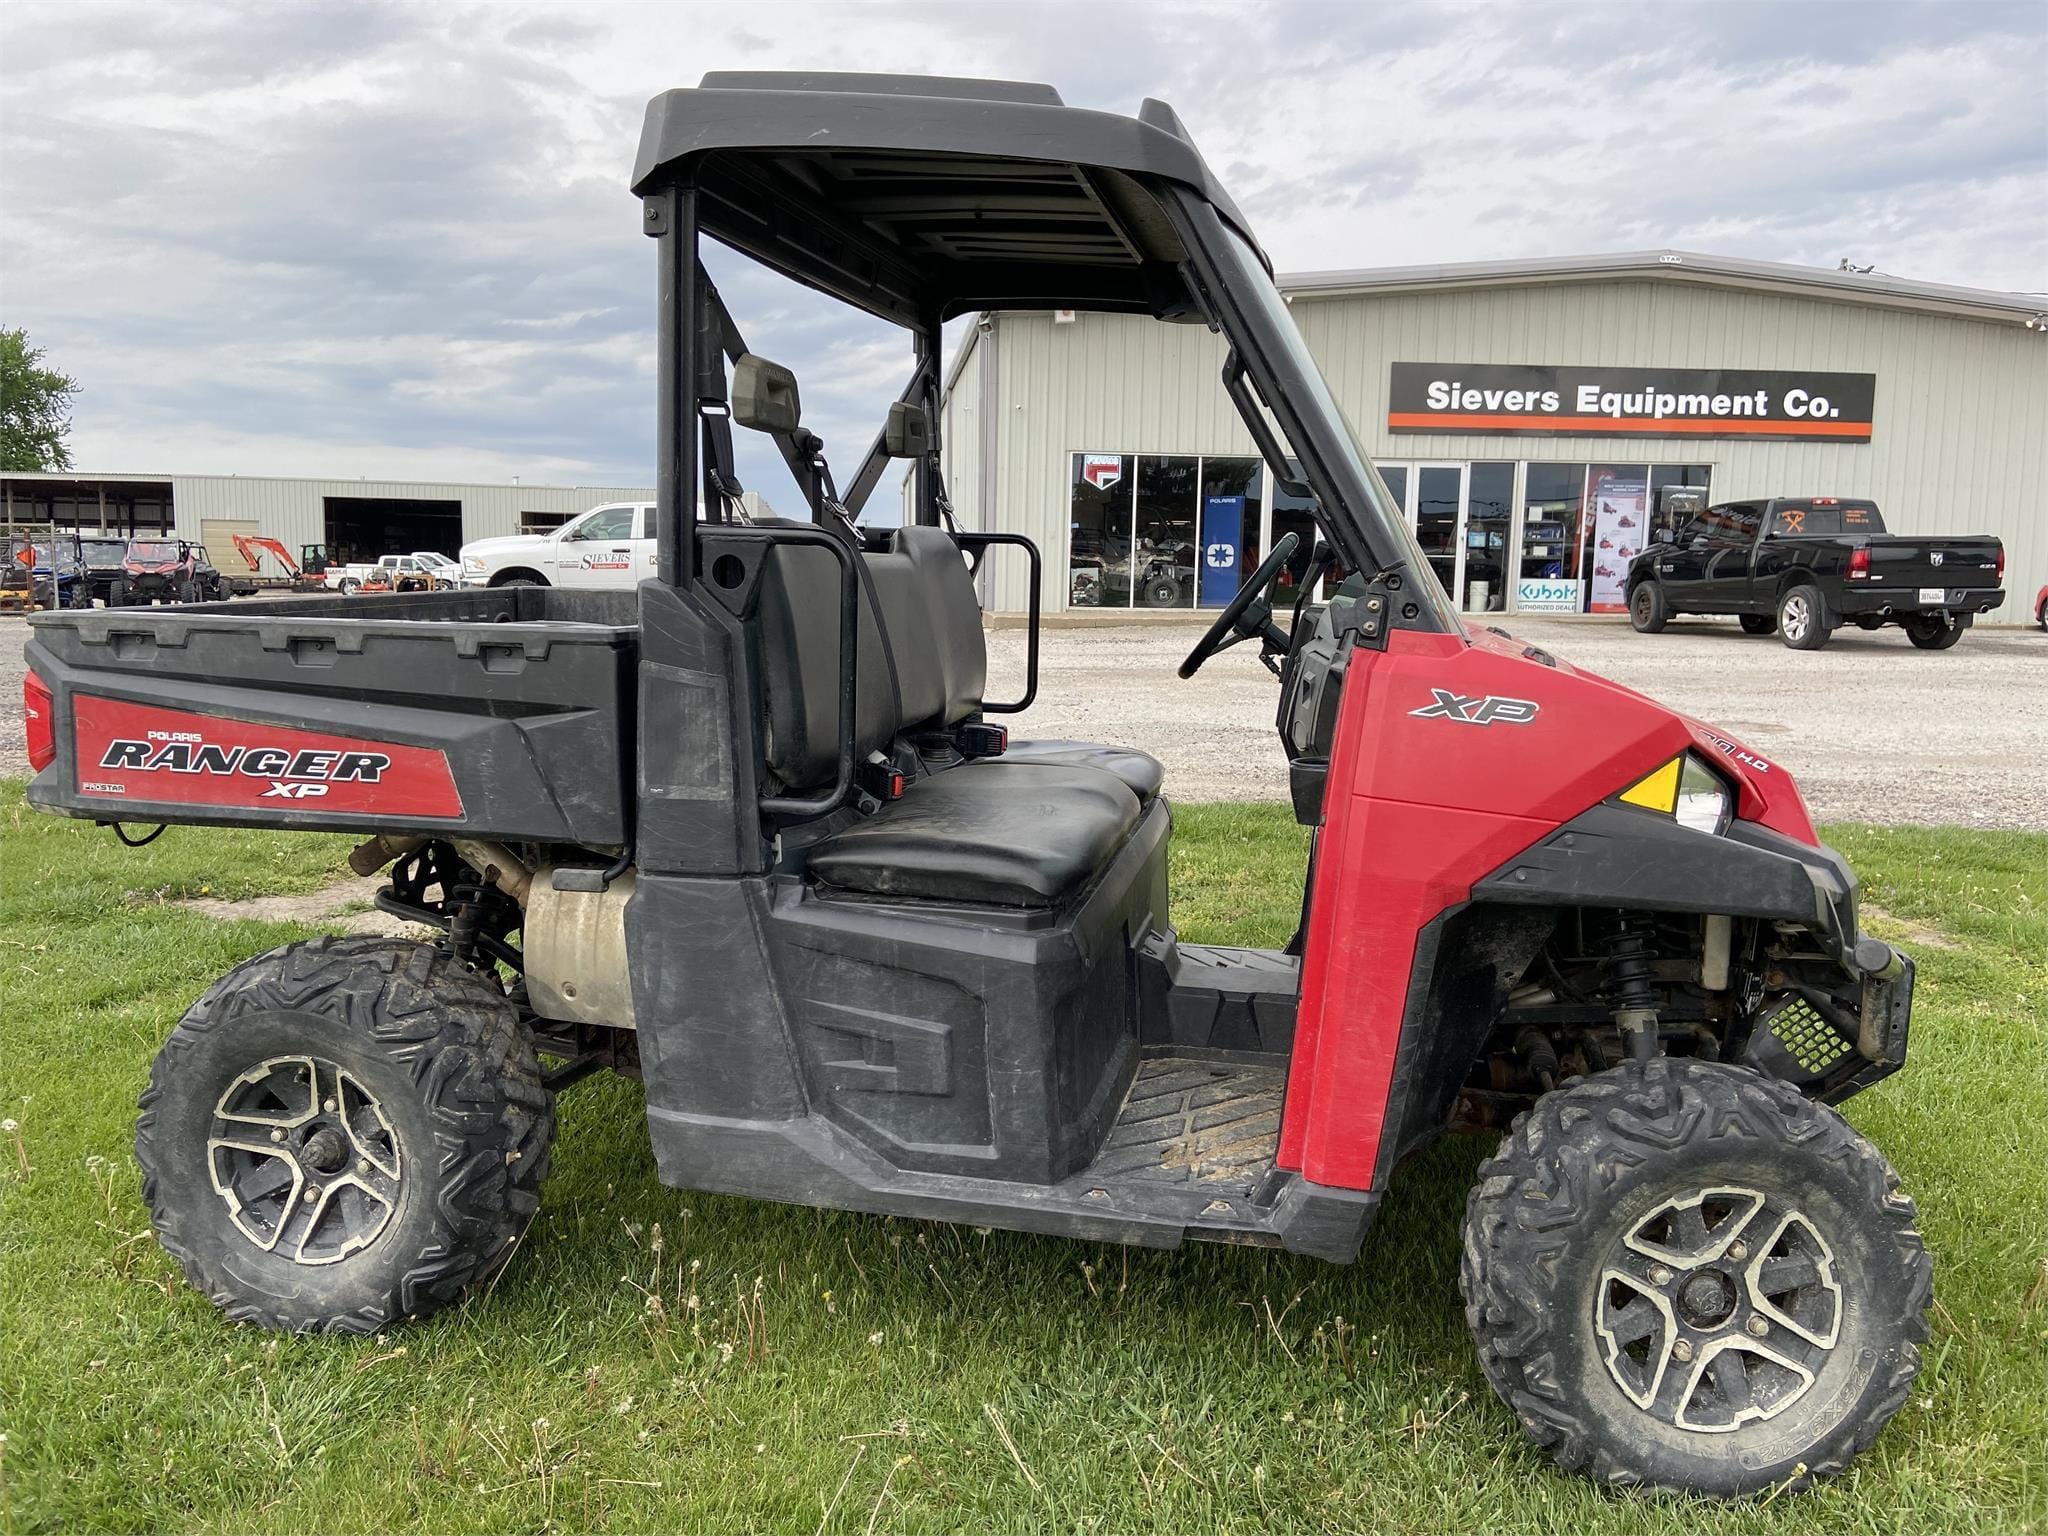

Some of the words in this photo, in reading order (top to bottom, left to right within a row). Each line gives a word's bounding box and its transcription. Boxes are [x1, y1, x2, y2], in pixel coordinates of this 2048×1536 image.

[1426, 381, 1560, 412] Sievers
[1576, 385, 1768, 419] Equipment
[1783, 388, 1839, 418] Co.
[580, 553, 631, 570] SIEVERS
[1406, 687, 1540, 725] XP
[147, 730, 202, 742] POLARIS
[99, 738, 392, 783] RANGER
[1736, 751, 1769, 773] H.D.
[260, 781, 330, 798] XP
